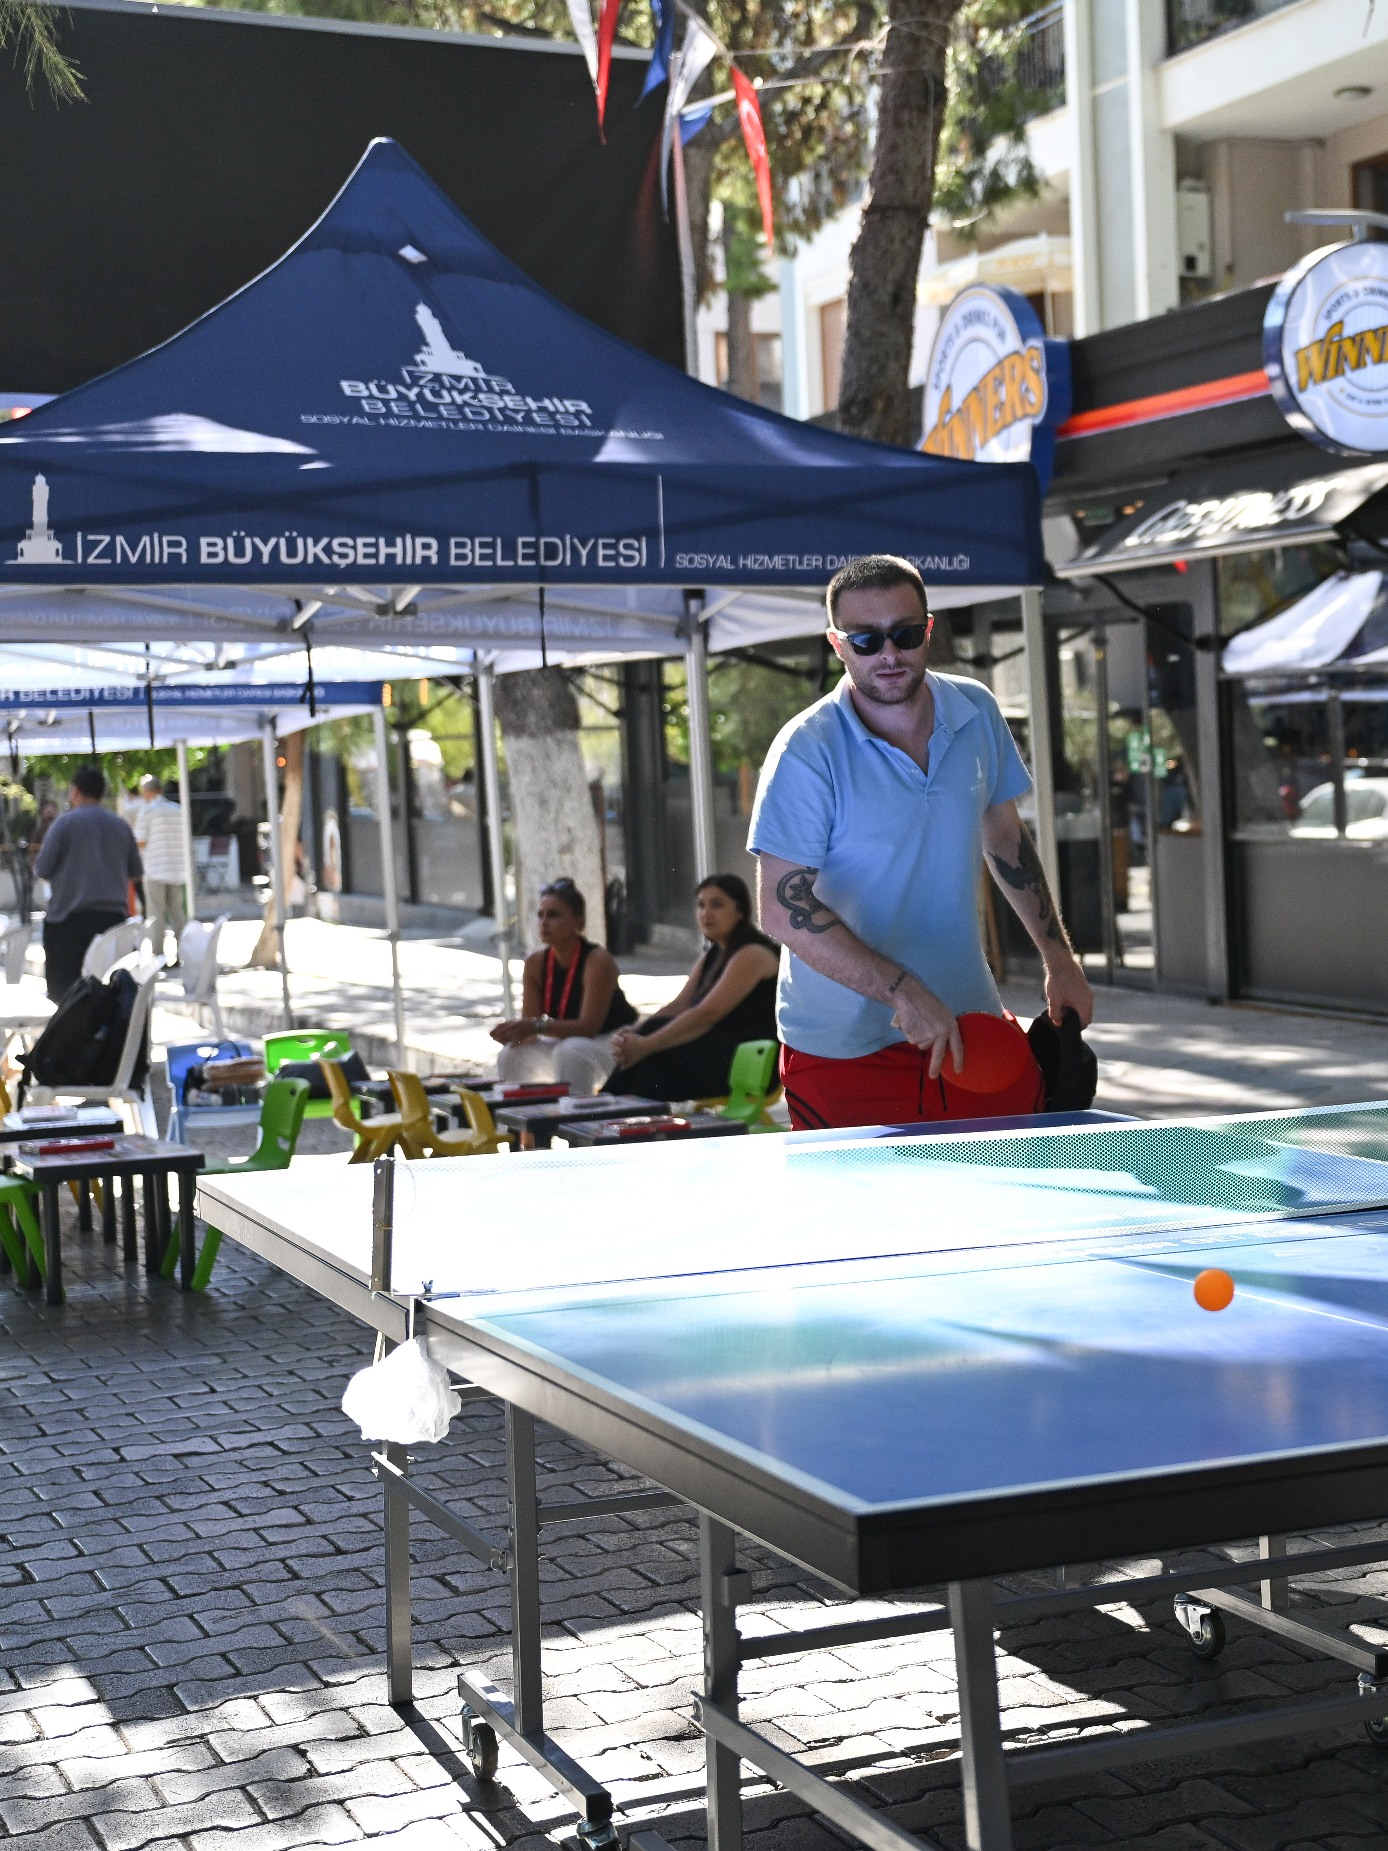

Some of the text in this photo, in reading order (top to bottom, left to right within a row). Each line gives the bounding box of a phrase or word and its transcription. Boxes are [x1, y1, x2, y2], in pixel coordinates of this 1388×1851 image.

[300, 414, 377, 426] SOSYAL
[77, 531, 647, 568] İZMİR BÜYÜKŞEHİR BELEDİYESİ
[676, 553, 735, 570] SOSYAL
[739, 553, 823, 571] HİZMETLER
